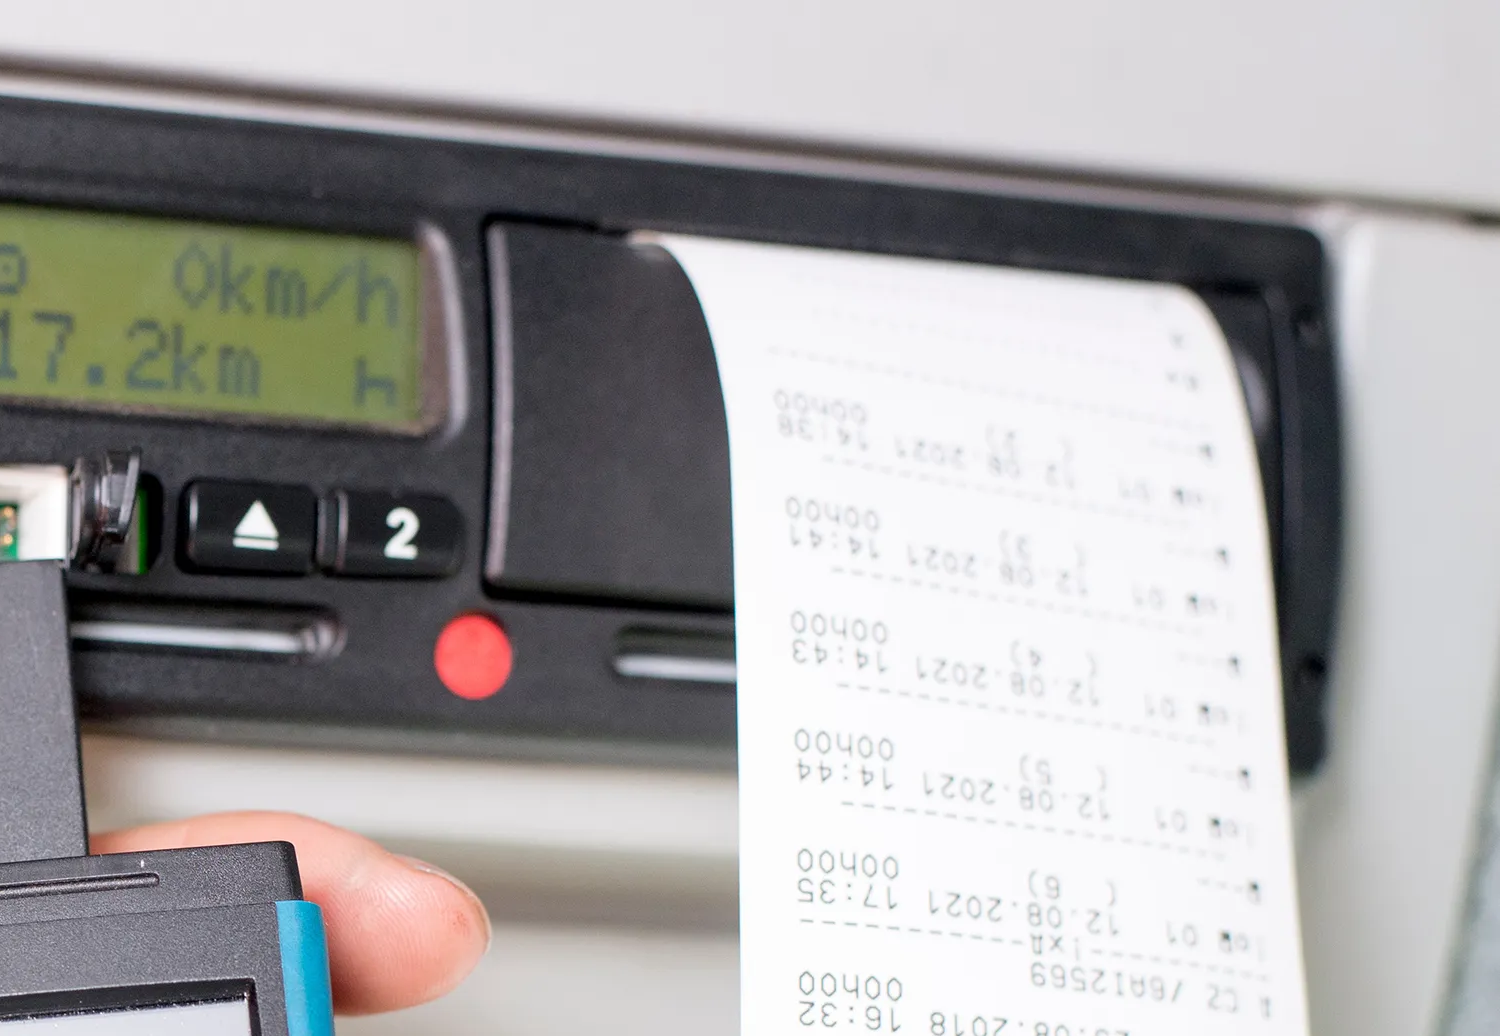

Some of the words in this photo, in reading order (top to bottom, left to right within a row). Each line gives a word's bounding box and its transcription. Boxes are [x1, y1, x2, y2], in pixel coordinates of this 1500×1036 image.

[173, 243, 400, 327] 0km/h
[785, 495, 880, 534] 00h00
[384, 507, 420, 561] 2
[790, 524, 880, 560] 14:41
[790, 610, 888, 645] 00h00
[792, 638, 888, 674] 14:43
[794, 728, 894, 762] 00h00
[797, 759, 893, 791] 14:44
[797, 848, 899, 881] 00h00
[798, 877, 897, 910] 17:35
[929, 890, 1119, 940] 12.08.2021
[799, 971, 902, 1002] 00h00
[1207, 983, 1239, 1014] CZ
[799, 1001, 901, 1032] 16:32
